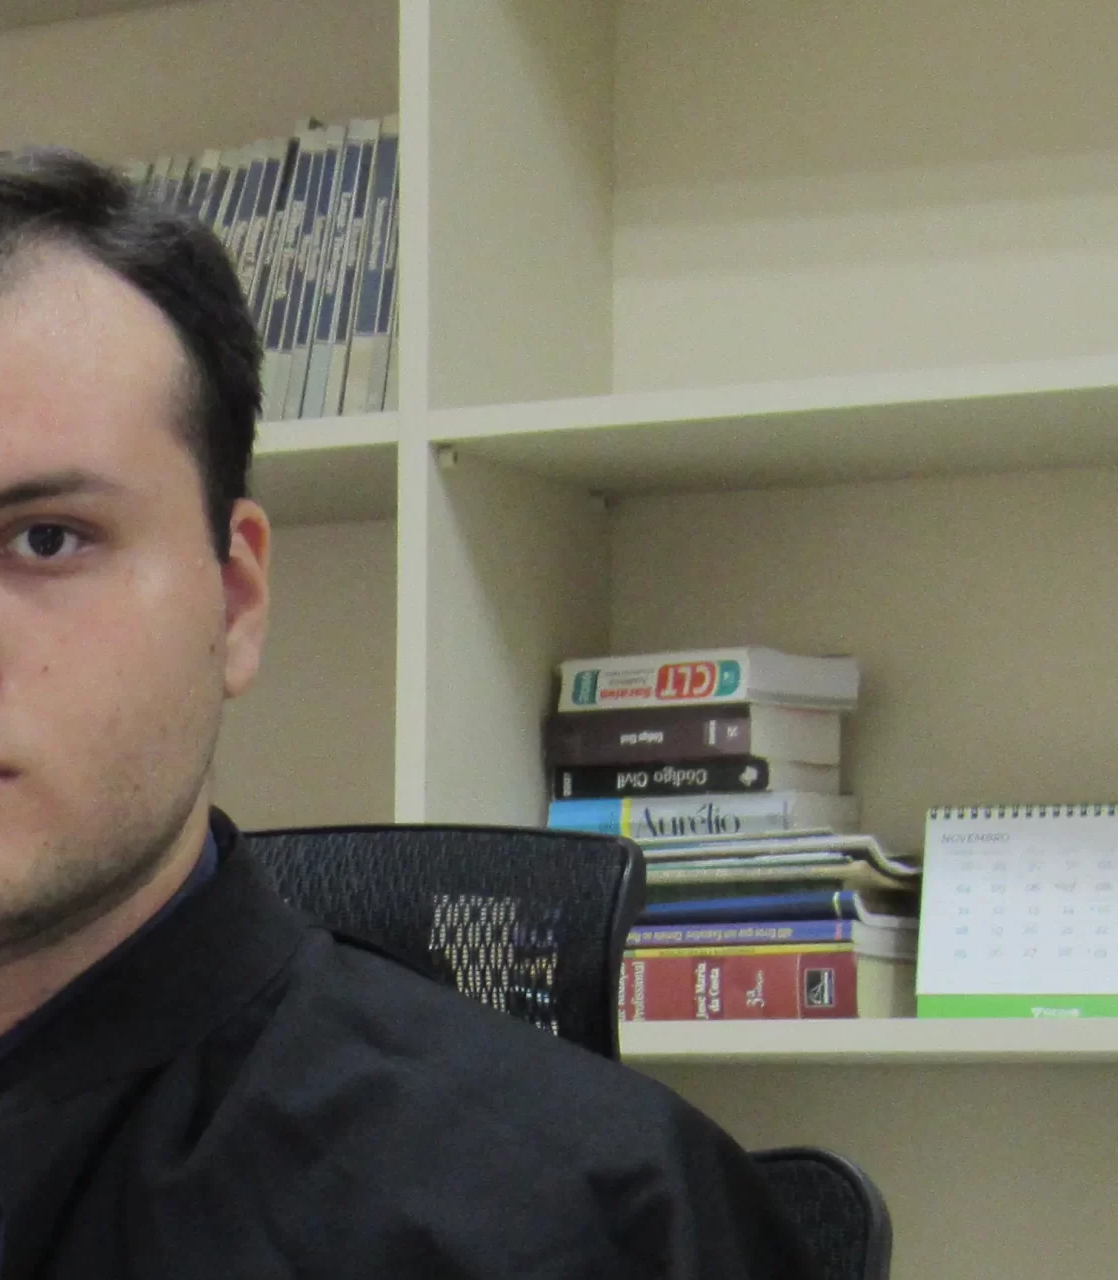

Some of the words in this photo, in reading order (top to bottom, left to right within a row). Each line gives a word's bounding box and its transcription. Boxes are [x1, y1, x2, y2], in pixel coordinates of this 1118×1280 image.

[661, 664, 712, 697] CLT
[600, 686, 653, 700] Saraiva
[616, 772, 648, 789] Civil
[653, 765, 708, 787] Código
[637, 802, 741, 837] Aurélio
[941, 832, 1010, 844] NOVEMBRO
[695, 962, 707, 993] Maria
[709, 967, 720, 995] Costa
[631, 961, 645, 1021] Profissional
[694, 996, 709, 1020] José
[708, 996, 720, 1013] da
